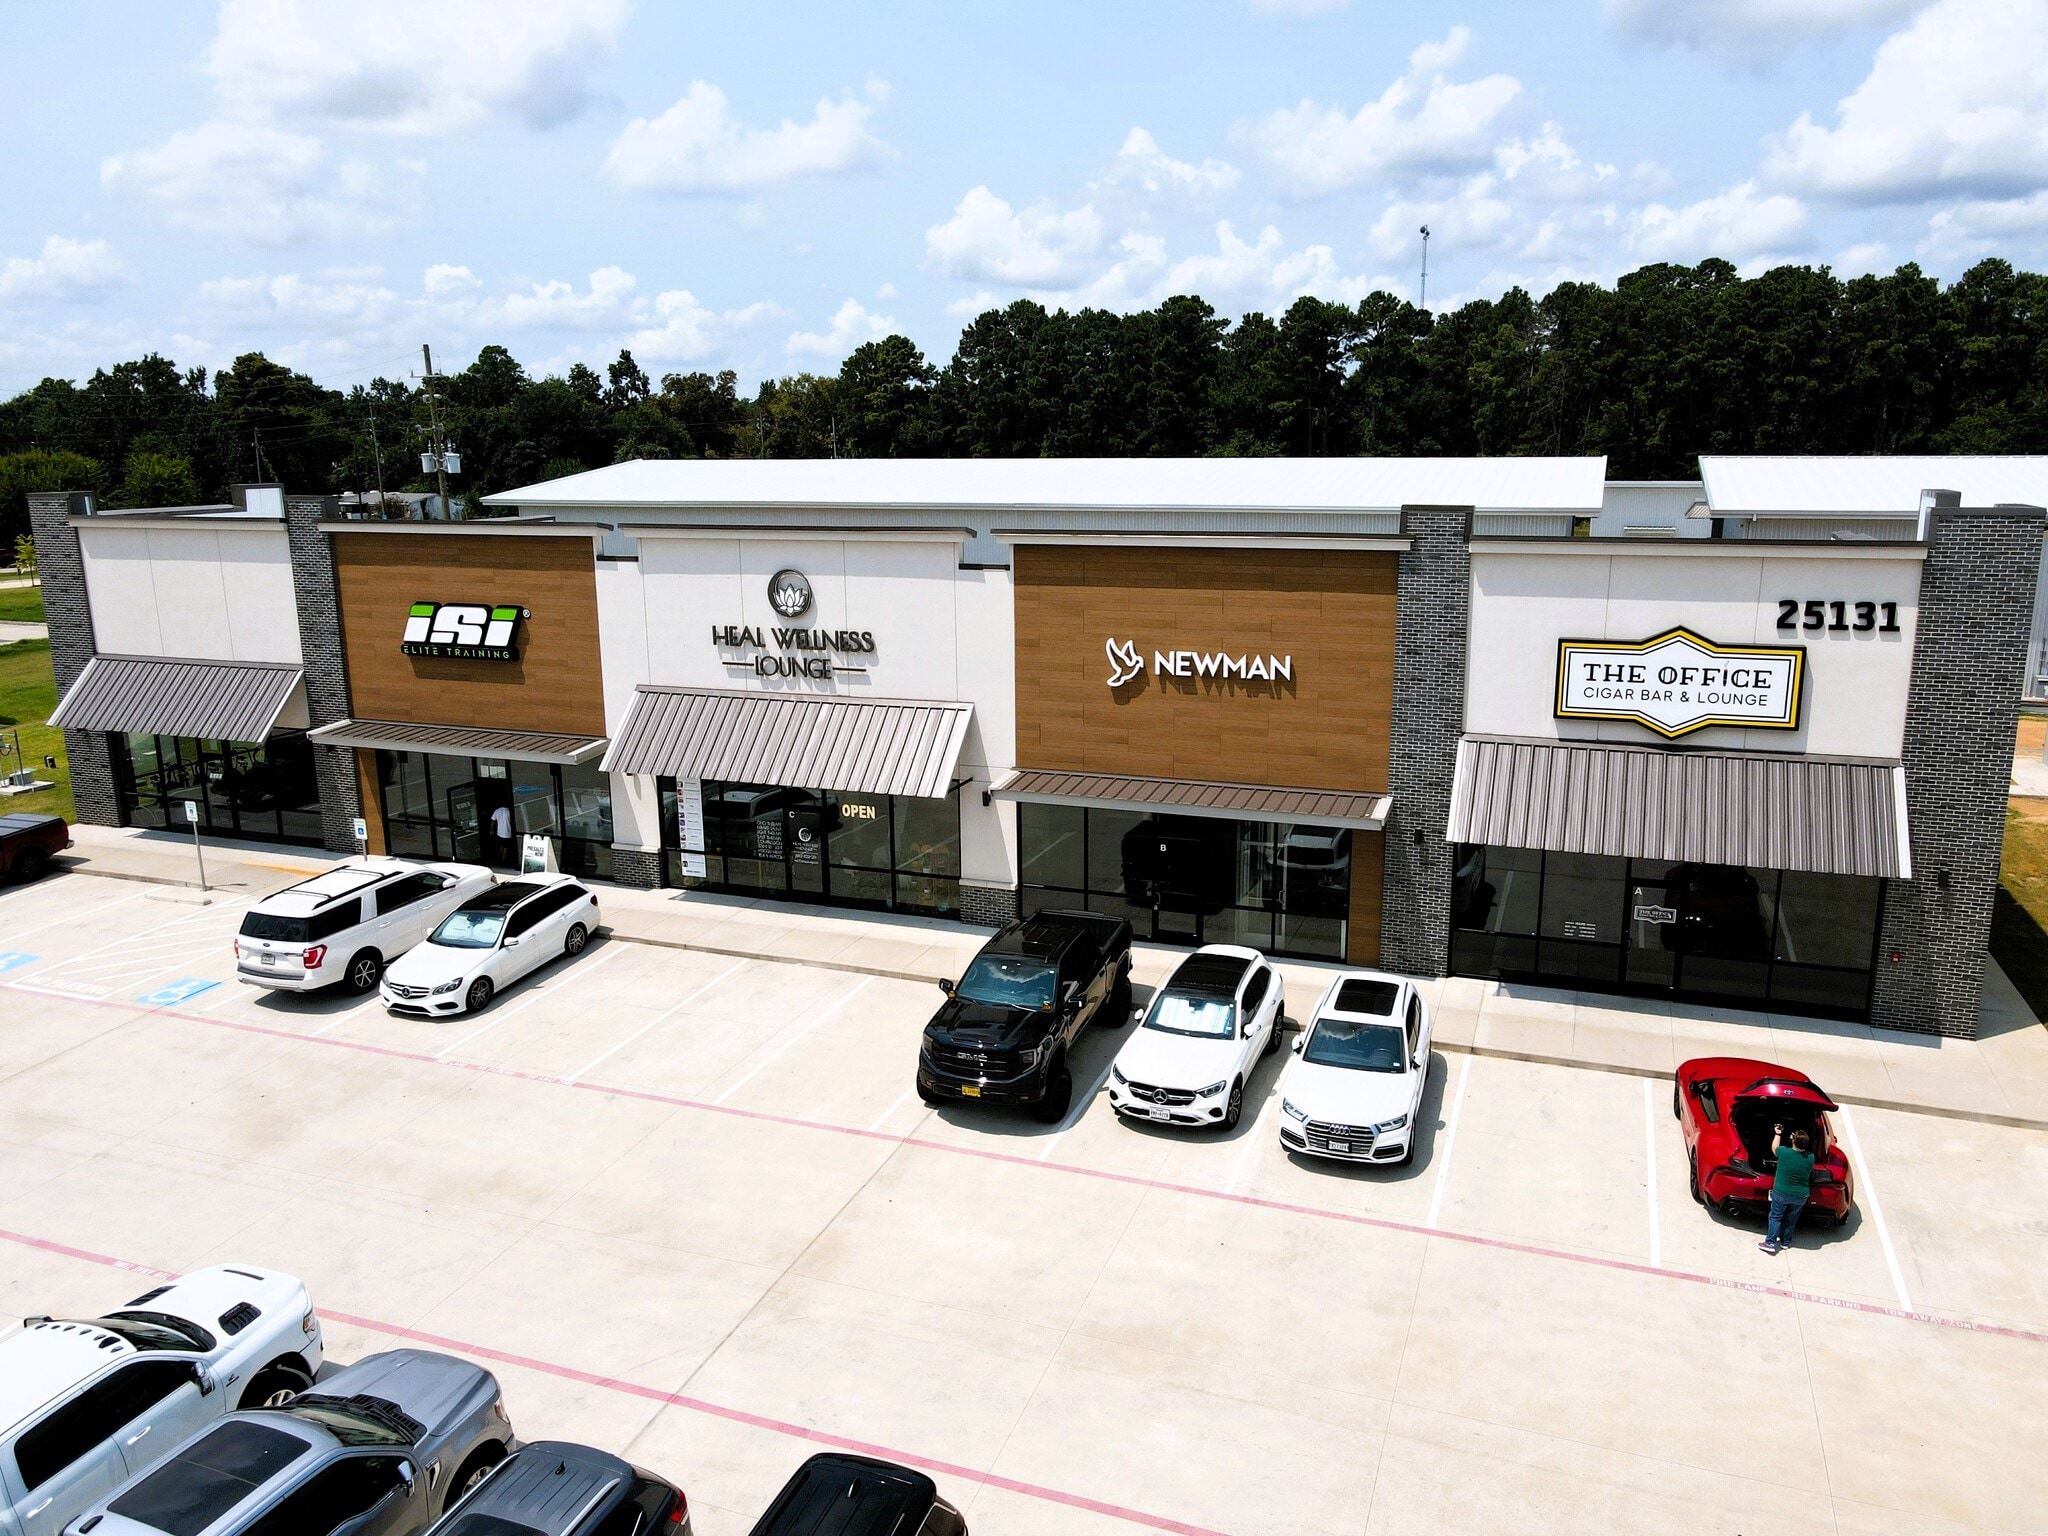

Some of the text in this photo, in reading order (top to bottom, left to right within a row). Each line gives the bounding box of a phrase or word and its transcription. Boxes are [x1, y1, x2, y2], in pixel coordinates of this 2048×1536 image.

[1776, 600, 1901, 632] 25131
[712, 625, 875, 652] HEAL WELLNESS
[403, 645, 510, 659] ELITE TRAINING
[755, 655, 832, 679] LOUNGE
[1154, 650, 1292, 681] NEWMAN
[1583, 663, 1772, 689] THE OFFICE
[1583, 687, 1769, 706] CIGAR BAR & LOUNGE
[842, 803, 876, 819] OPEN
[1160, 844, 1167, 852] B
[1634, 887, 1643, 895] A
[1709, 1278, 1735, 1288] FIRE
[1791, 1291, 1806, 1300] NO
[1811, 1295, 1862, 1310] PARKING
[1883, 1308, 1906, 1318] TOW
[1912, 1313, 1944, 1325] AWAY
[1949, 1319, 1980, 1331] ZONE
